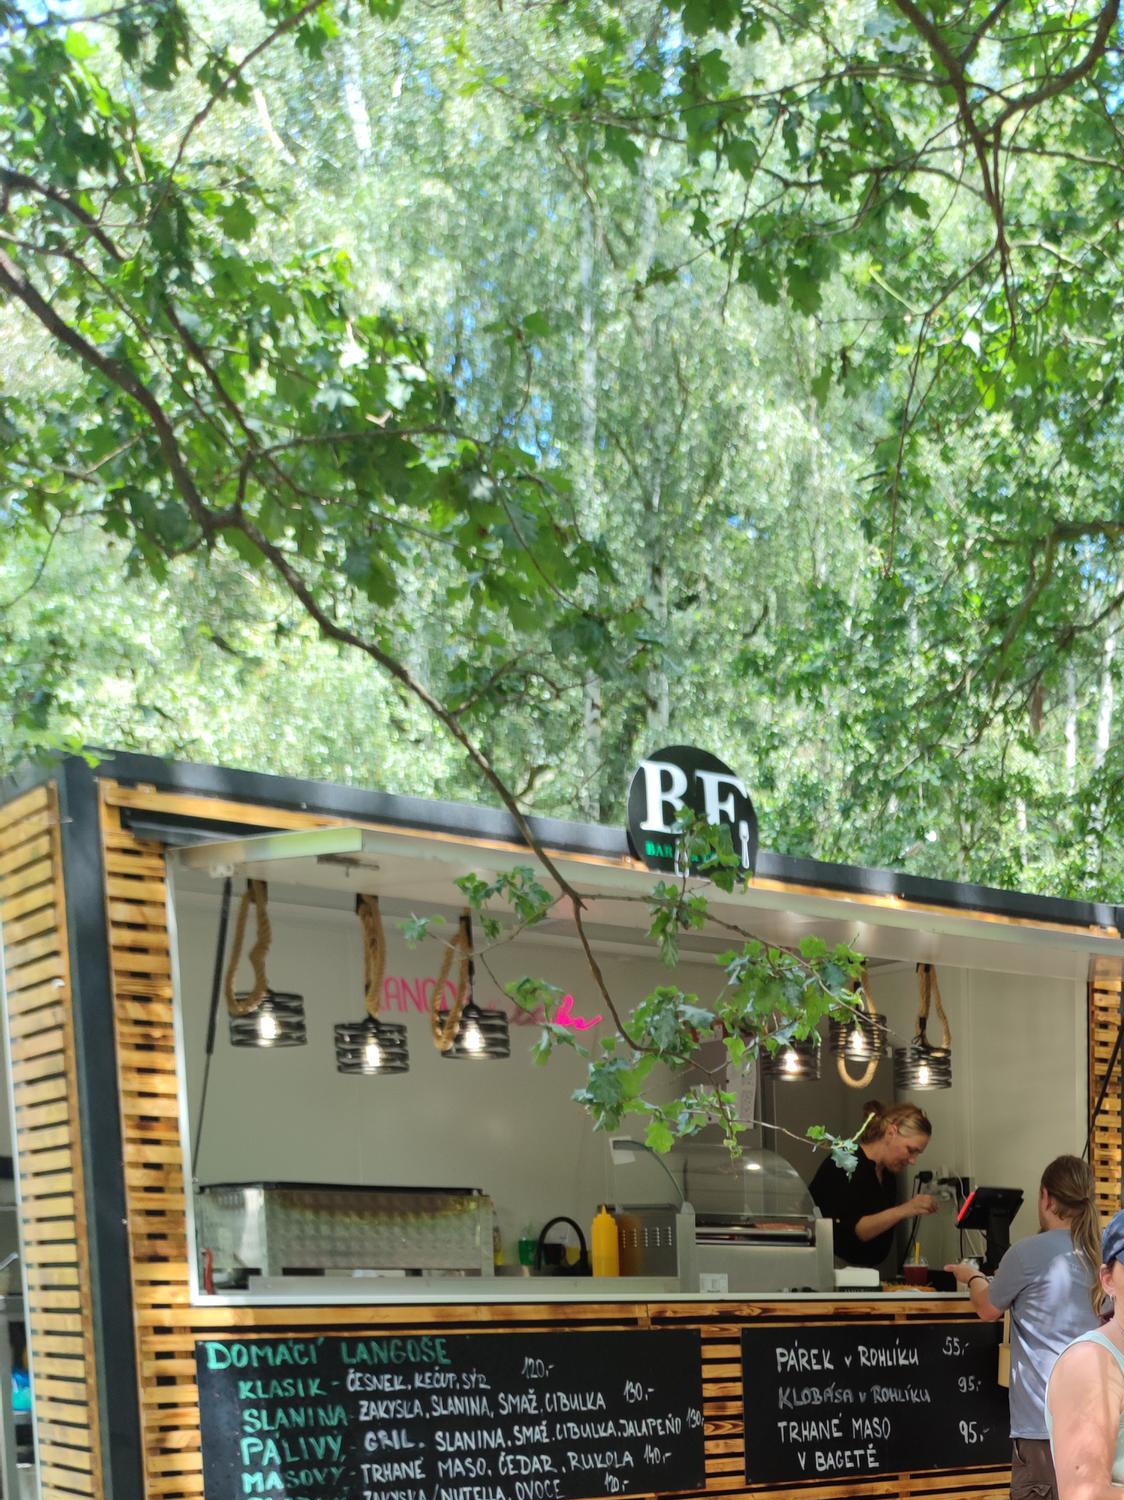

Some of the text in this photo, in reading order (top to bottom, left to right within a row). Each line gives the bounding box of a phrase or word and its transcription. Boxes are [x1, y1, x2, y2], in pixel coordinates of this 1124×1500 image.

[341, 1336, 451, 1364] LANGOŠE
[776, 1340, 834, 1373] PÁREK
[858, 1338, 920, 1368] ROHLÍKU
[238, 1377, 327, 1400] KLASIK
[777, 1382, 854, 1410] KLOBÁSA
[870, 1385, 931, 1404] ROHLÍKU
[243, 1404, 349, 1434] SLANINA
[545, 1391, 606, 1413] CIBULKA
[777, 1412, 843, 1443] TRHANÉ
[851, 1416, 891, 1440] MASO
[567, 1451, 634, 1471] RUKOLA
